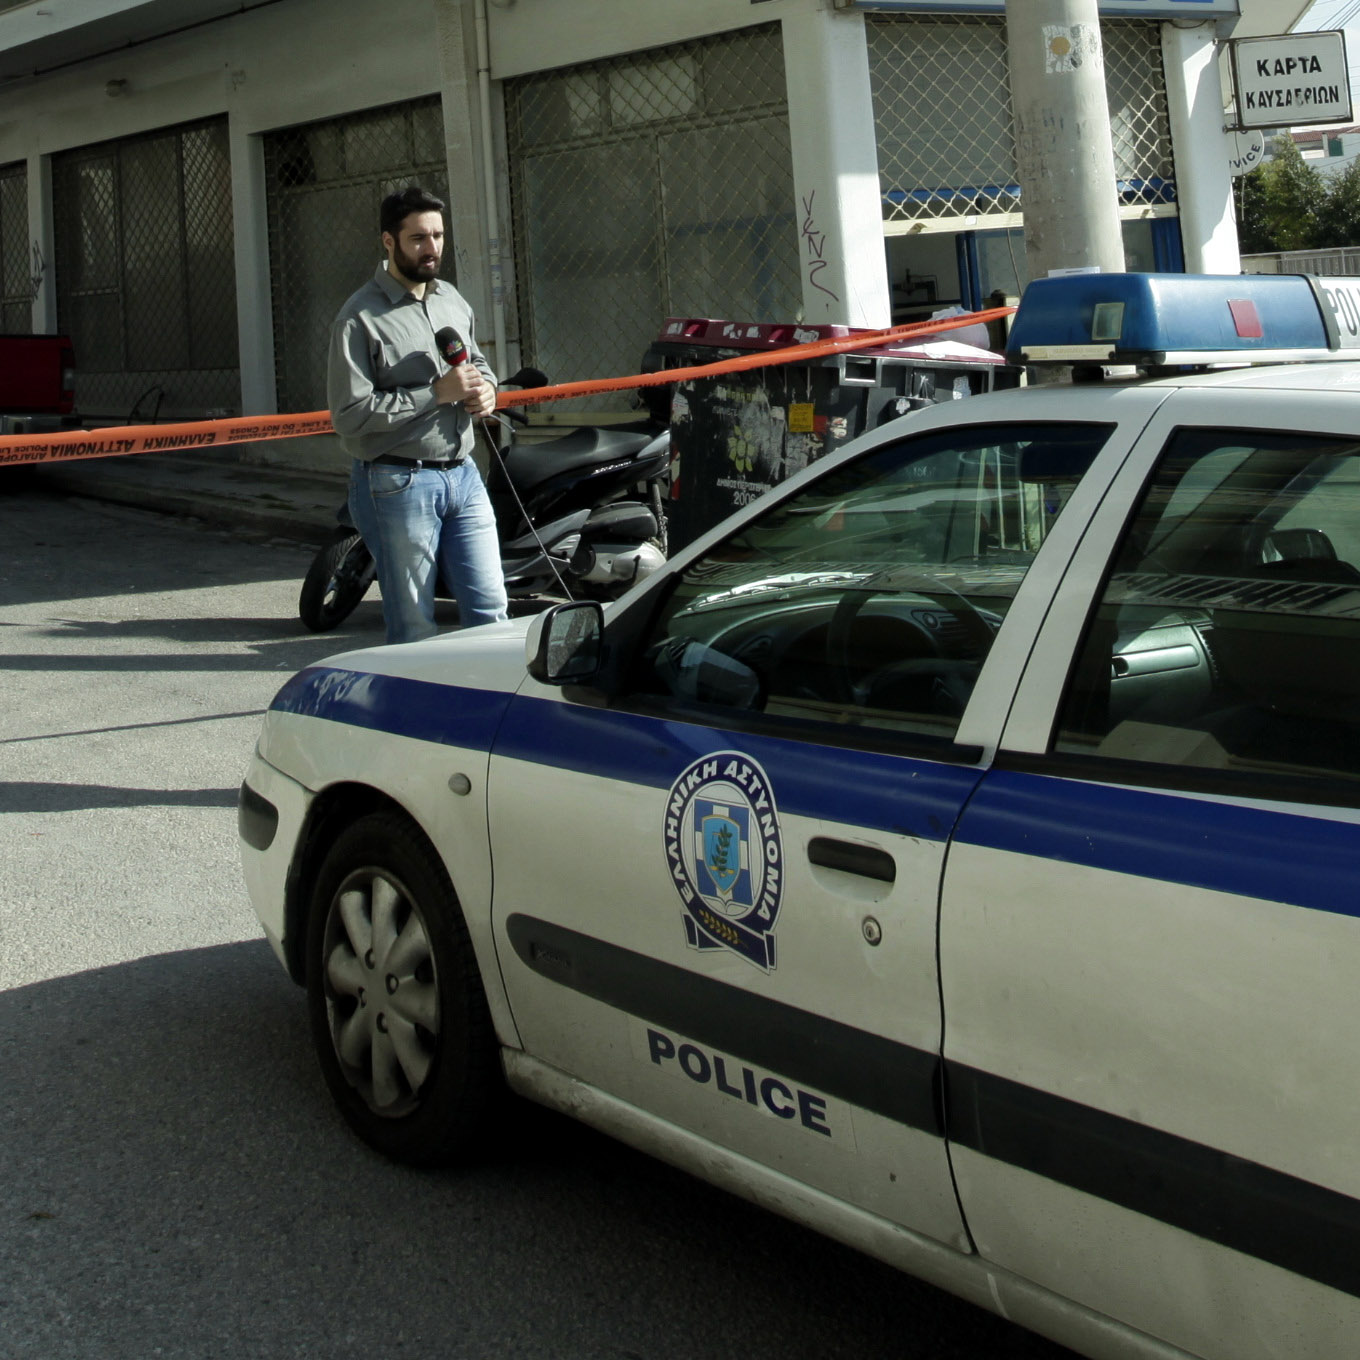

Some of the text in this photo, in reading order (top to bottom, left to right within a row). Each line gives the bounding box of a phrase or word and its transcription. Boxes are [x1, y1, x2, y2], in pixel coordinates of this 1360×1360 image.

[1256, 55, 1322, 77] ΚΑΡΤΑ
[13, 444, 48, 453] POLICE
[50, 438, 137, 458] ΑΣΤΥΝΟΜΙΑ
[143, 431, 217, 451] ΕΛΛΗΝΙΚΗ
[666, 759, 780, 921] ΕΛΛΗΝΙΚΗ ΑΣΤΥΝΟΜΙΑ
[647, 1027, 833, 1138] POLICE
